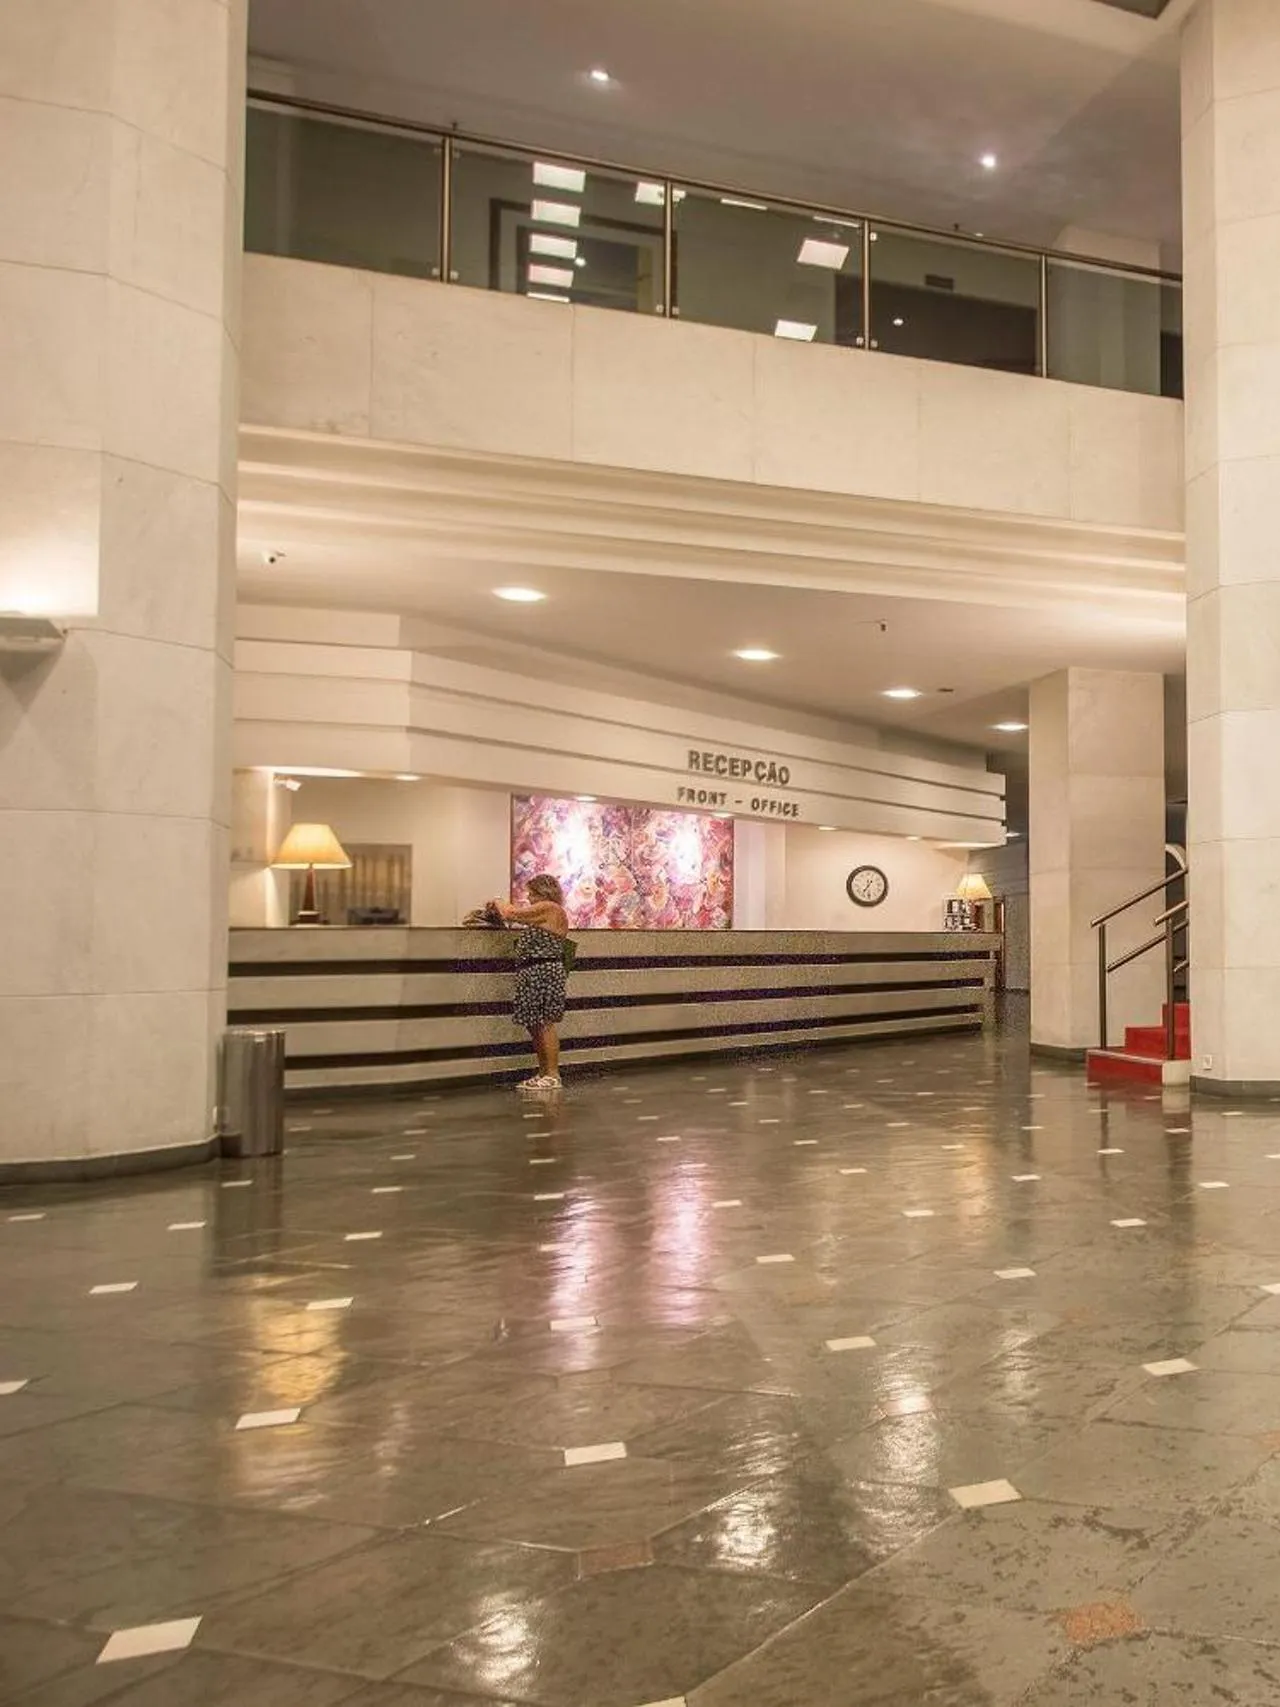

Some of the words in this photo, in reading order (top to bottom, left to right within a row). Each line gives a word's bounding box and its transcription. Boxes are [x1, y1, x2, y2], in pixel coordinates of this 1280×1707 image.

[688, 750, 790, 785] RECEPÇÃO
[677, 787, 727, 805] FRONT
[751, 798, 799, 817] OFFICE
